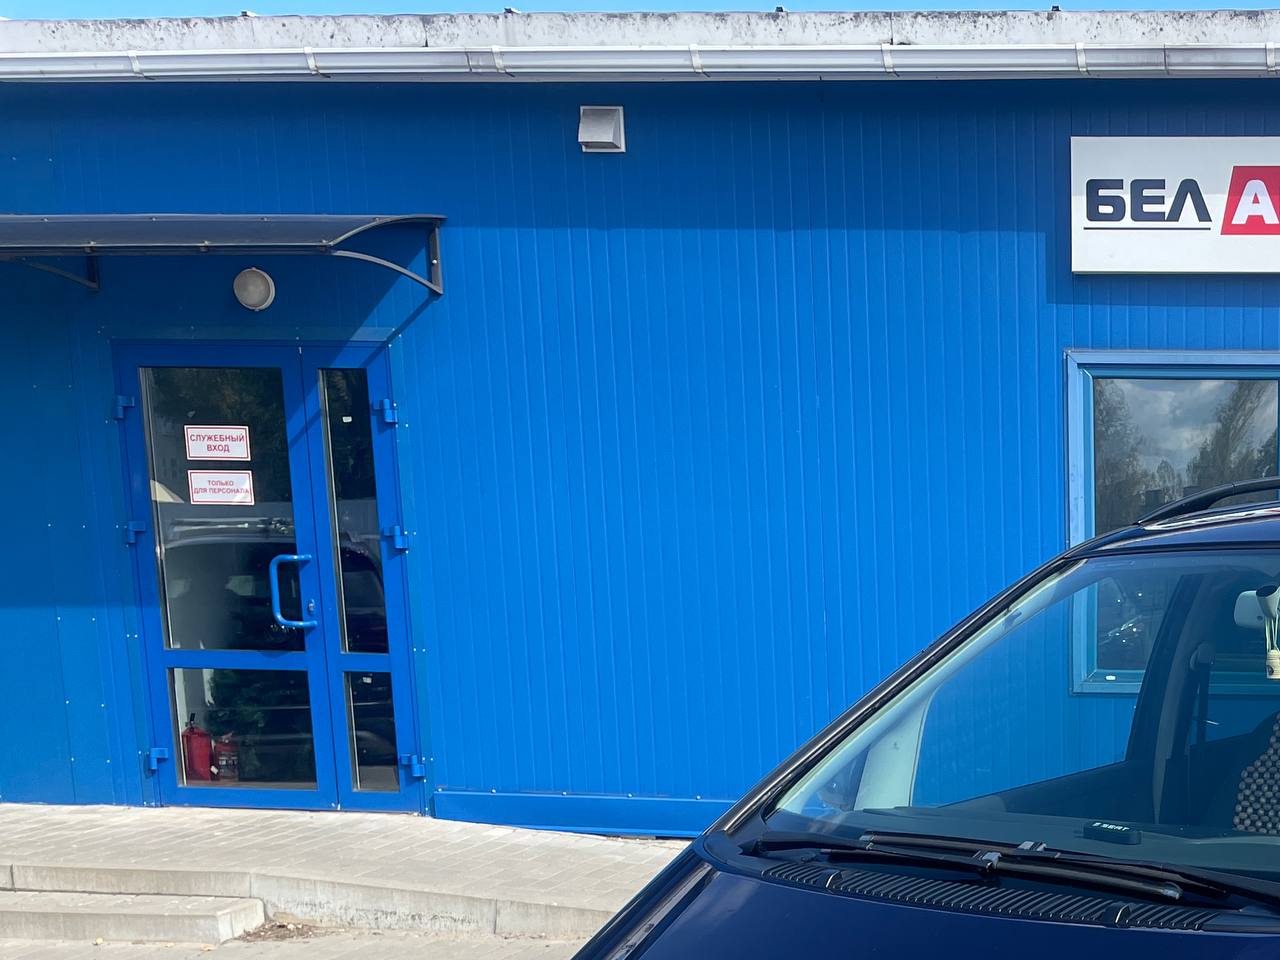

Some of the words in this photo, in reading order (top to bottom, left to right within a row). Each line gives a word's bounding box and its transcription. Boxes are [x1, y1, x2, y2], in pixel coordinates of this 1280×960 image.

[1084, 178, 1211, 223] БЕЛ
[189, 433, 245, 442] СЛУЖЕБНЫЙ
[206, 444, 230, 453] ВХОД
